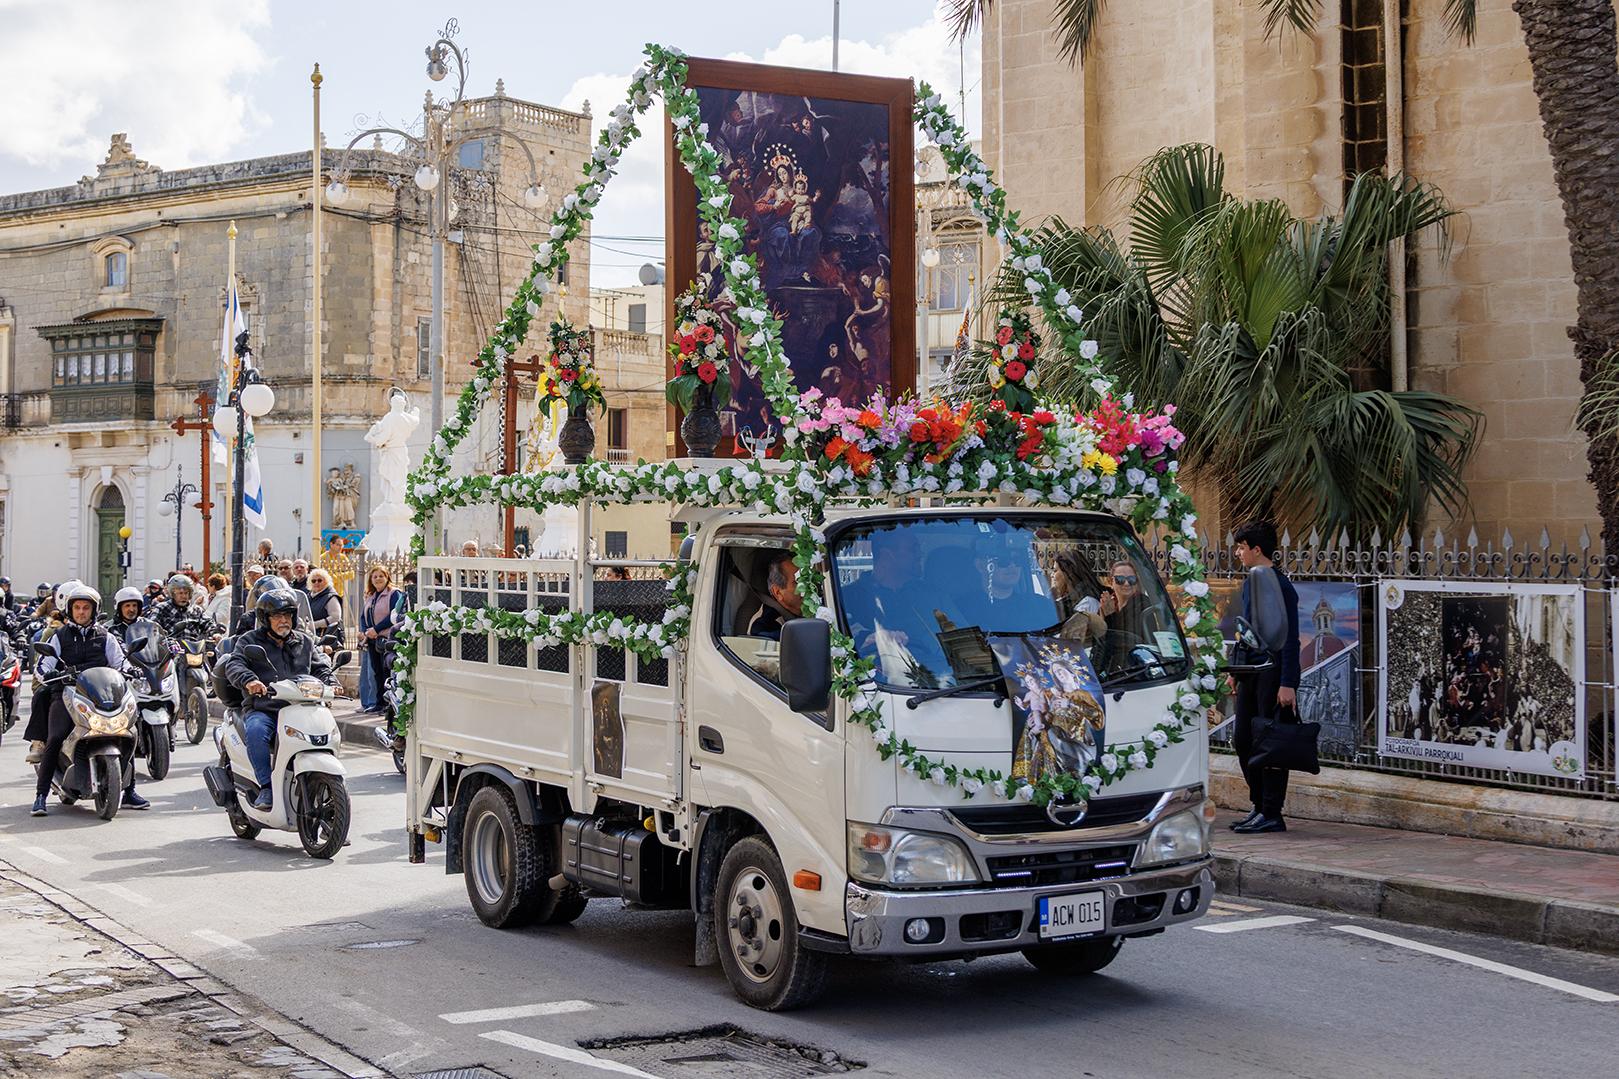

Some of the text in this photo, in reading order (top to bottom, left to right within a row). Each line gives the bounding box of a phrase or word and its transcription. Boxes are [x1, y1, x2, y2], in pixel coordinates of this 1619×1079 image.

[1385, 743, 1422, 756] TAL-ARKIVJU
[1052, 901, 1101, 926] ACW 015
